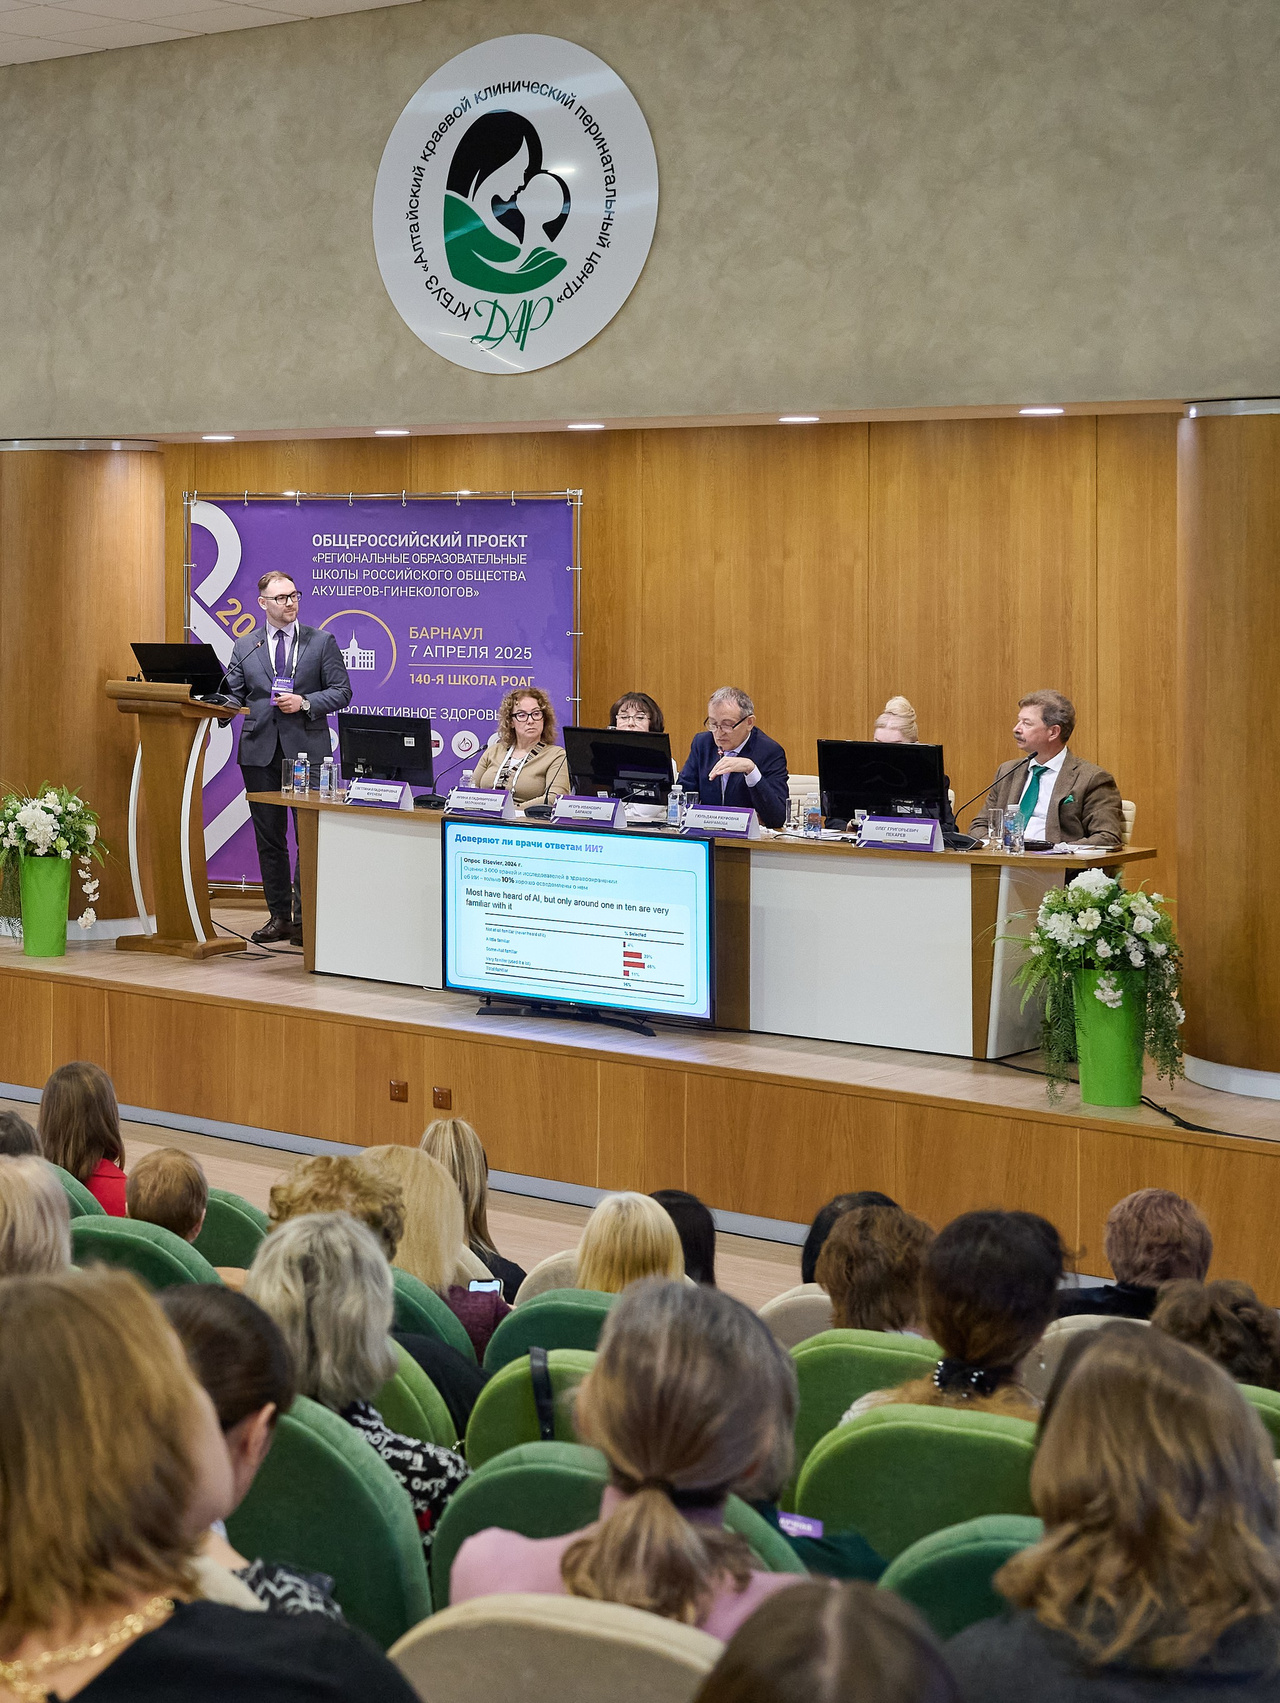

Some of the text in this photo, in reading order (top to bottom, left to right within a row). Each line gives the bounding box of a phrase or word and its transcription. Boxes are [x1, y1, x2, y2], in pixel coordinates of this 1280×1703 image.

[406, 80, 616, 321] КГБУЗ «Алтайский краевой клинический перинатальный центр»
[471, 296, 553, 352] ДАР
[312, 532, 528, 549] ОБЩЕРОССИЙСКИЙ ПРОЕКТ
[312, 553, 527, 565] «РЕГИОНАЛЬНЫЕ ОБРАЗОВАТЕЛЬНЫЕ
[312, 568, 526, 583] ШКОЛЫ РОССИЙСКОГО ОБЩЕСТВА
[312, 586, 479, 598] АКУШЕРОВ-ГИНЕКОЛОГОВ»
[216, 598, 256, 638] 20
[409, 627, 483, 640] БАРНАУЛ
[409, 645, 532, 660] 7 АПРЕЛЯ 2025
[410, 674, 535, 687] 140-Я ШКОЛА РОАГ
[326, 706, 500, 722] РОДУКТИВНОЕ ЗДОРОВЬ
[455, 834, 499, 845] Доверяют
[516, 840, 542, 848] врачи
[545, 842, 582, 851] ответам
[585, 844, 603, 853] ИИ?
[466, 888, 482, 896] Most
[484, 890, 501, 899] have
[503, 891, 522, 900] heard
[532, 894, 542, 903] AI,
[544, 895, 556, 904] but
[557, 896, 572, 906] only
[574, 898, 598, 908] around
[625, 902, 637, 912] ten
[639, 905, 651, 913] are
[653, 906, 669, 916] very
[466, 899, 490, 908] familiar
[492, 901, 506, 909] with
